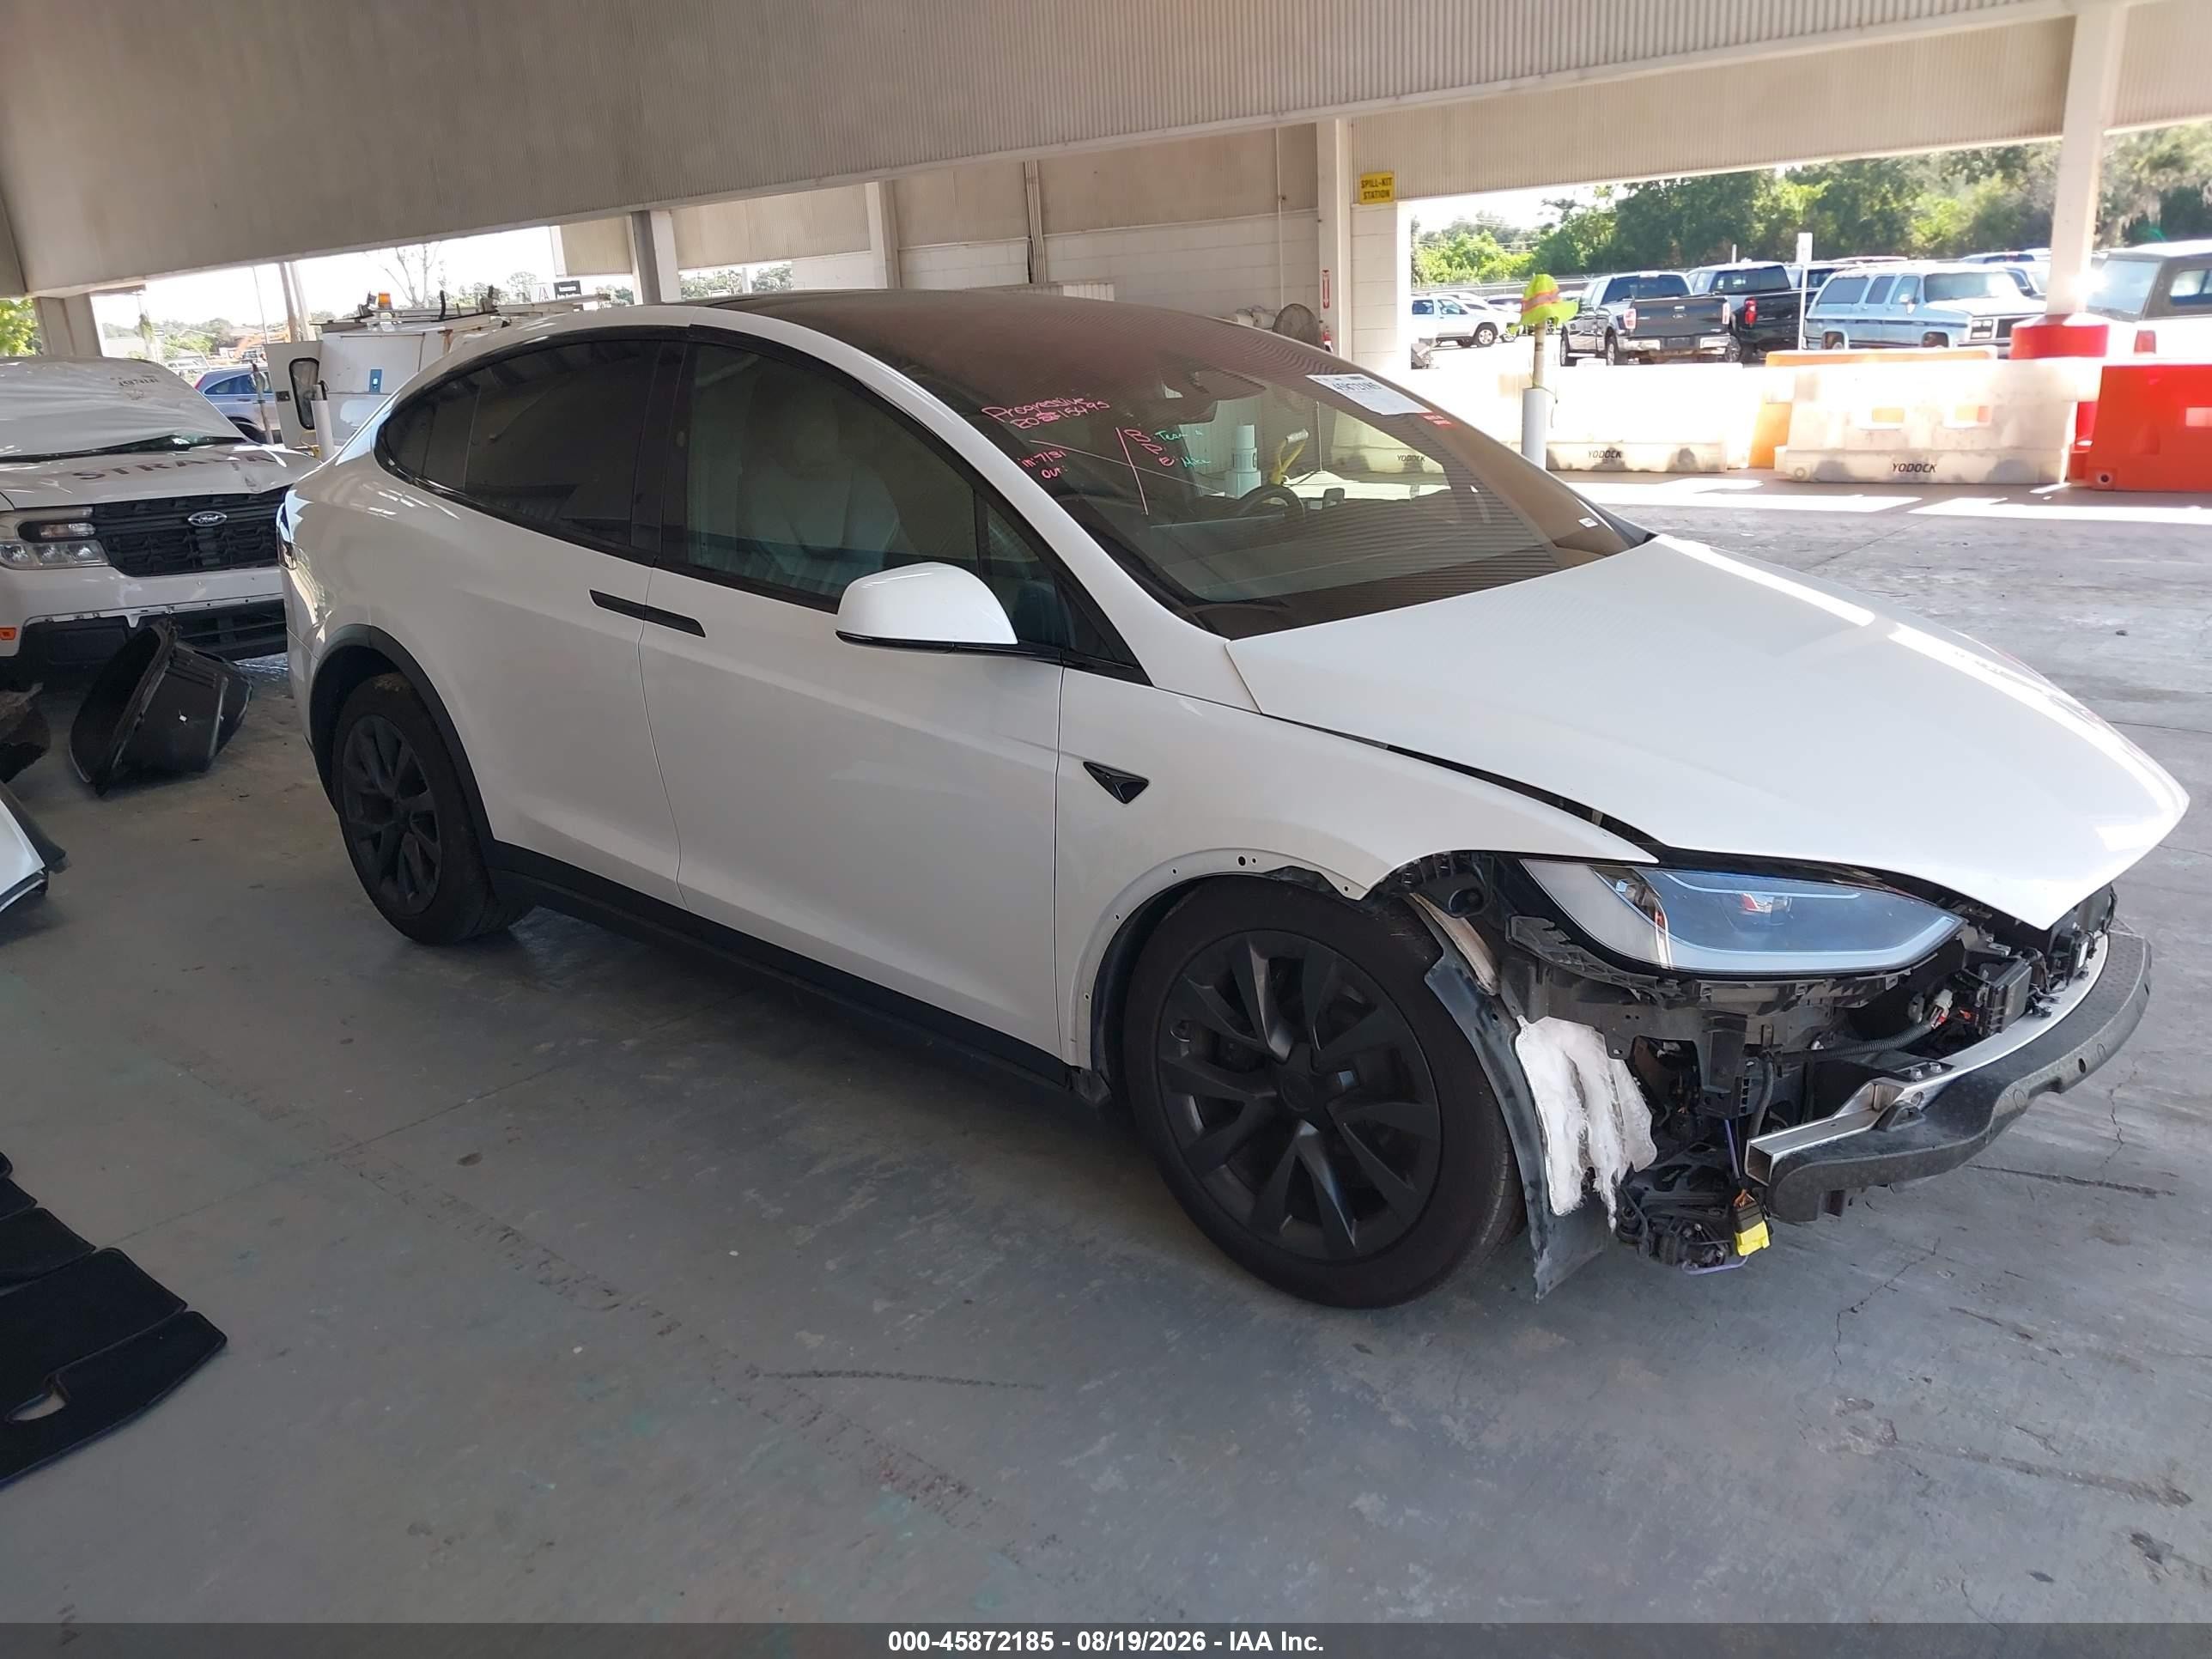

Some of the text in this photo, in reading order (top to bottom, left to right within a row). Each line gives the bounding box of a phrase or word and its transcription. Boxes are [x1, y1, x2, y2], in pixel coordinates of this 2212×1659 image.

[1361, 177, 1393, 188] SPILL-KIT
[1364, 190, 1390, 199] STATION
[1589, 450, 1622, 459] YODOCK
[1893, 463, 1937, 473] YODOCK
